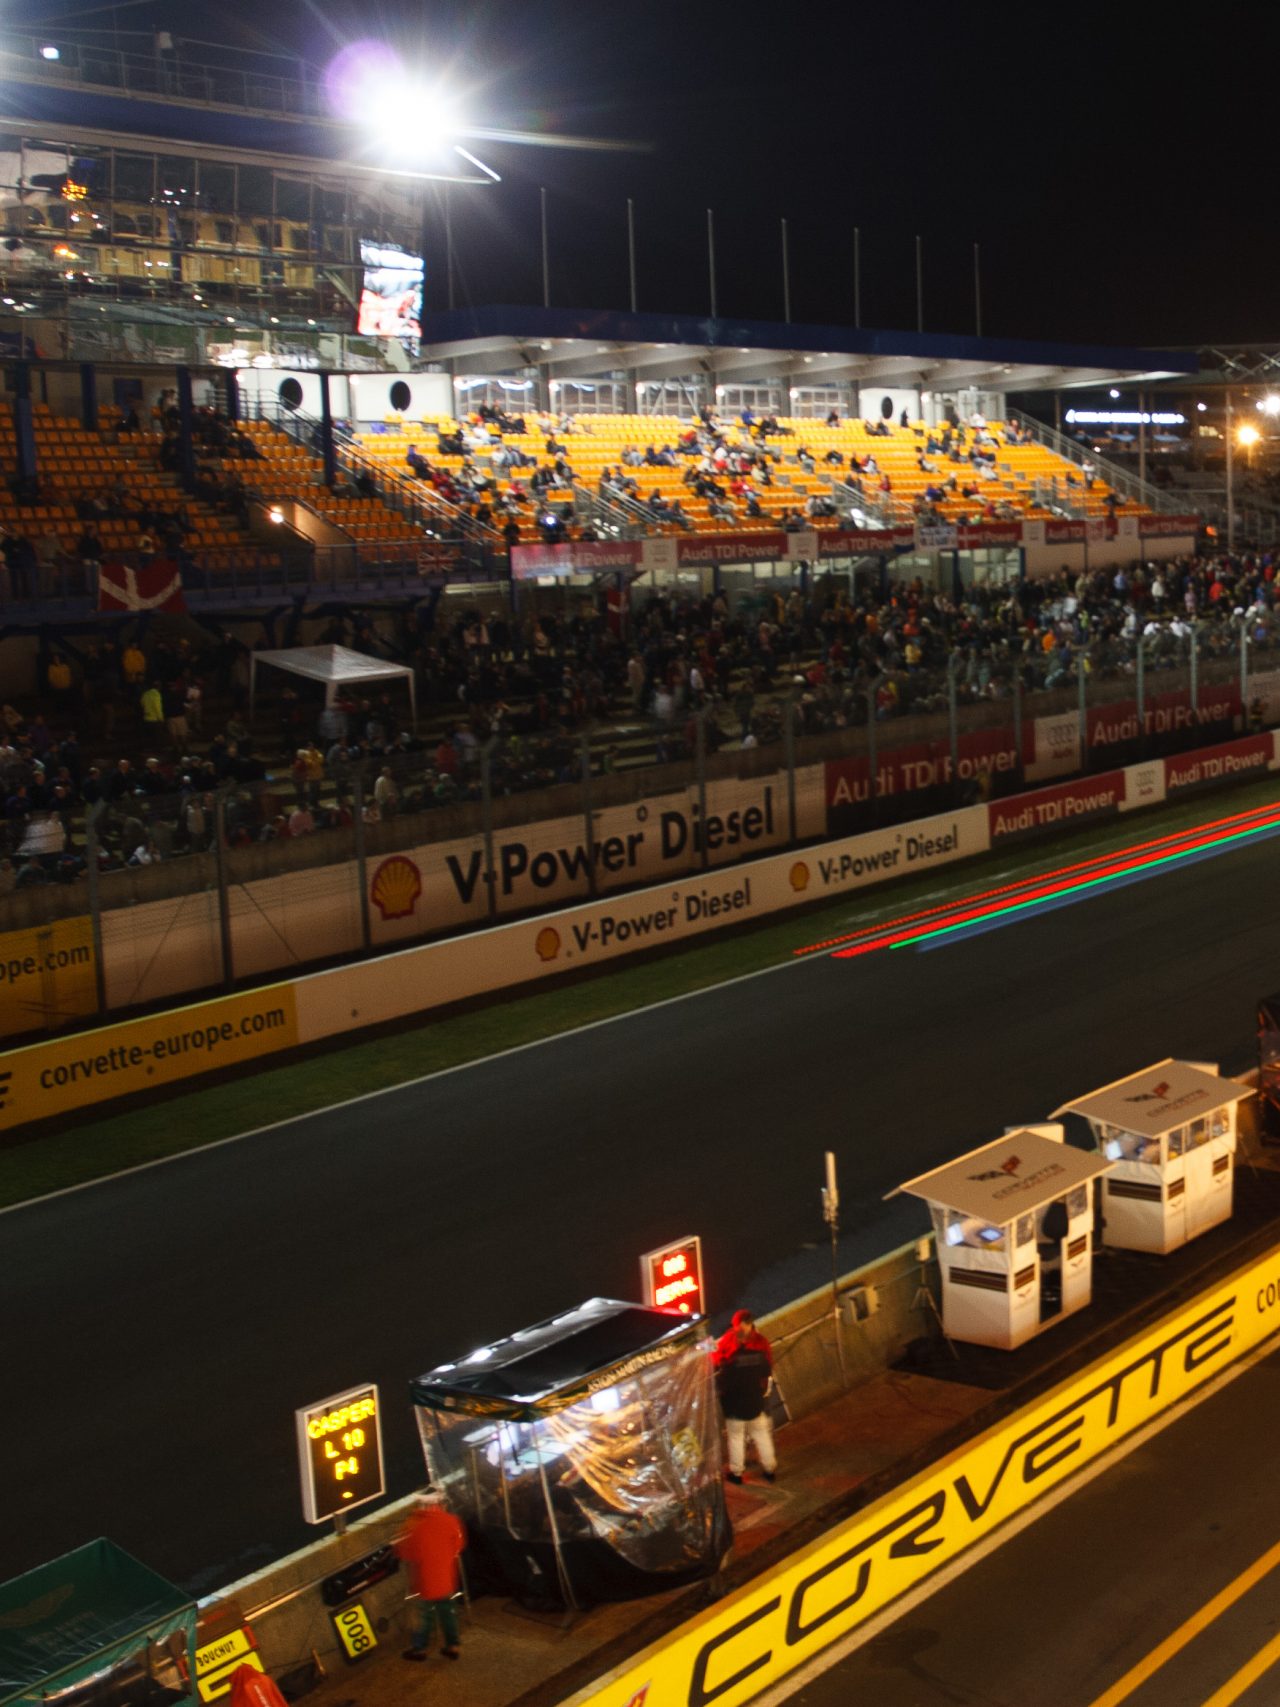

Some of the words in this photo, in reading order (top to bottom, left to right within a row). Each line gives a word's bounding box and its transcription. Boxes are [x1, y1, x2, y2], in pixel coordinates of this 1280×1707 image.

[682, 544, 713, 561] Audi
[714, 543, 738, 559] TDI
[739, 542, 780, 558] Power
[1092, 715, 1138, 747] Audi
[832, 765, 894, 807] Audi
[901, 760, 938, 792] TDI
[1167, 763, 1200, 788] Audi
[1201, 758, 1223, 779] TDI
[1225, 750, 1266, 771] Power
[994, 807, 1034, 837] Audi
[1035, 801, 1062, 827] TDI
[1064, 789, 1114, 818] Power
[445, 832, 644, 904] V-Power
[660, 786, 773, 860] Diesel
[818, 850, 900, 885] V-Power
[905, 825, 958, 862] Diesel
[573, 907, 678, 953] V-Power
[685, 878, 751, 922] Diesel
[40, 1007, 285, 1089] corvette-europe.com
[307, 1398, 376, 1439] CASPER
[324, 1440, 340, 1459] L
[688, 1296, 1237, 1707] CORVETTE
[341, 1610, 370, 1652] 008
